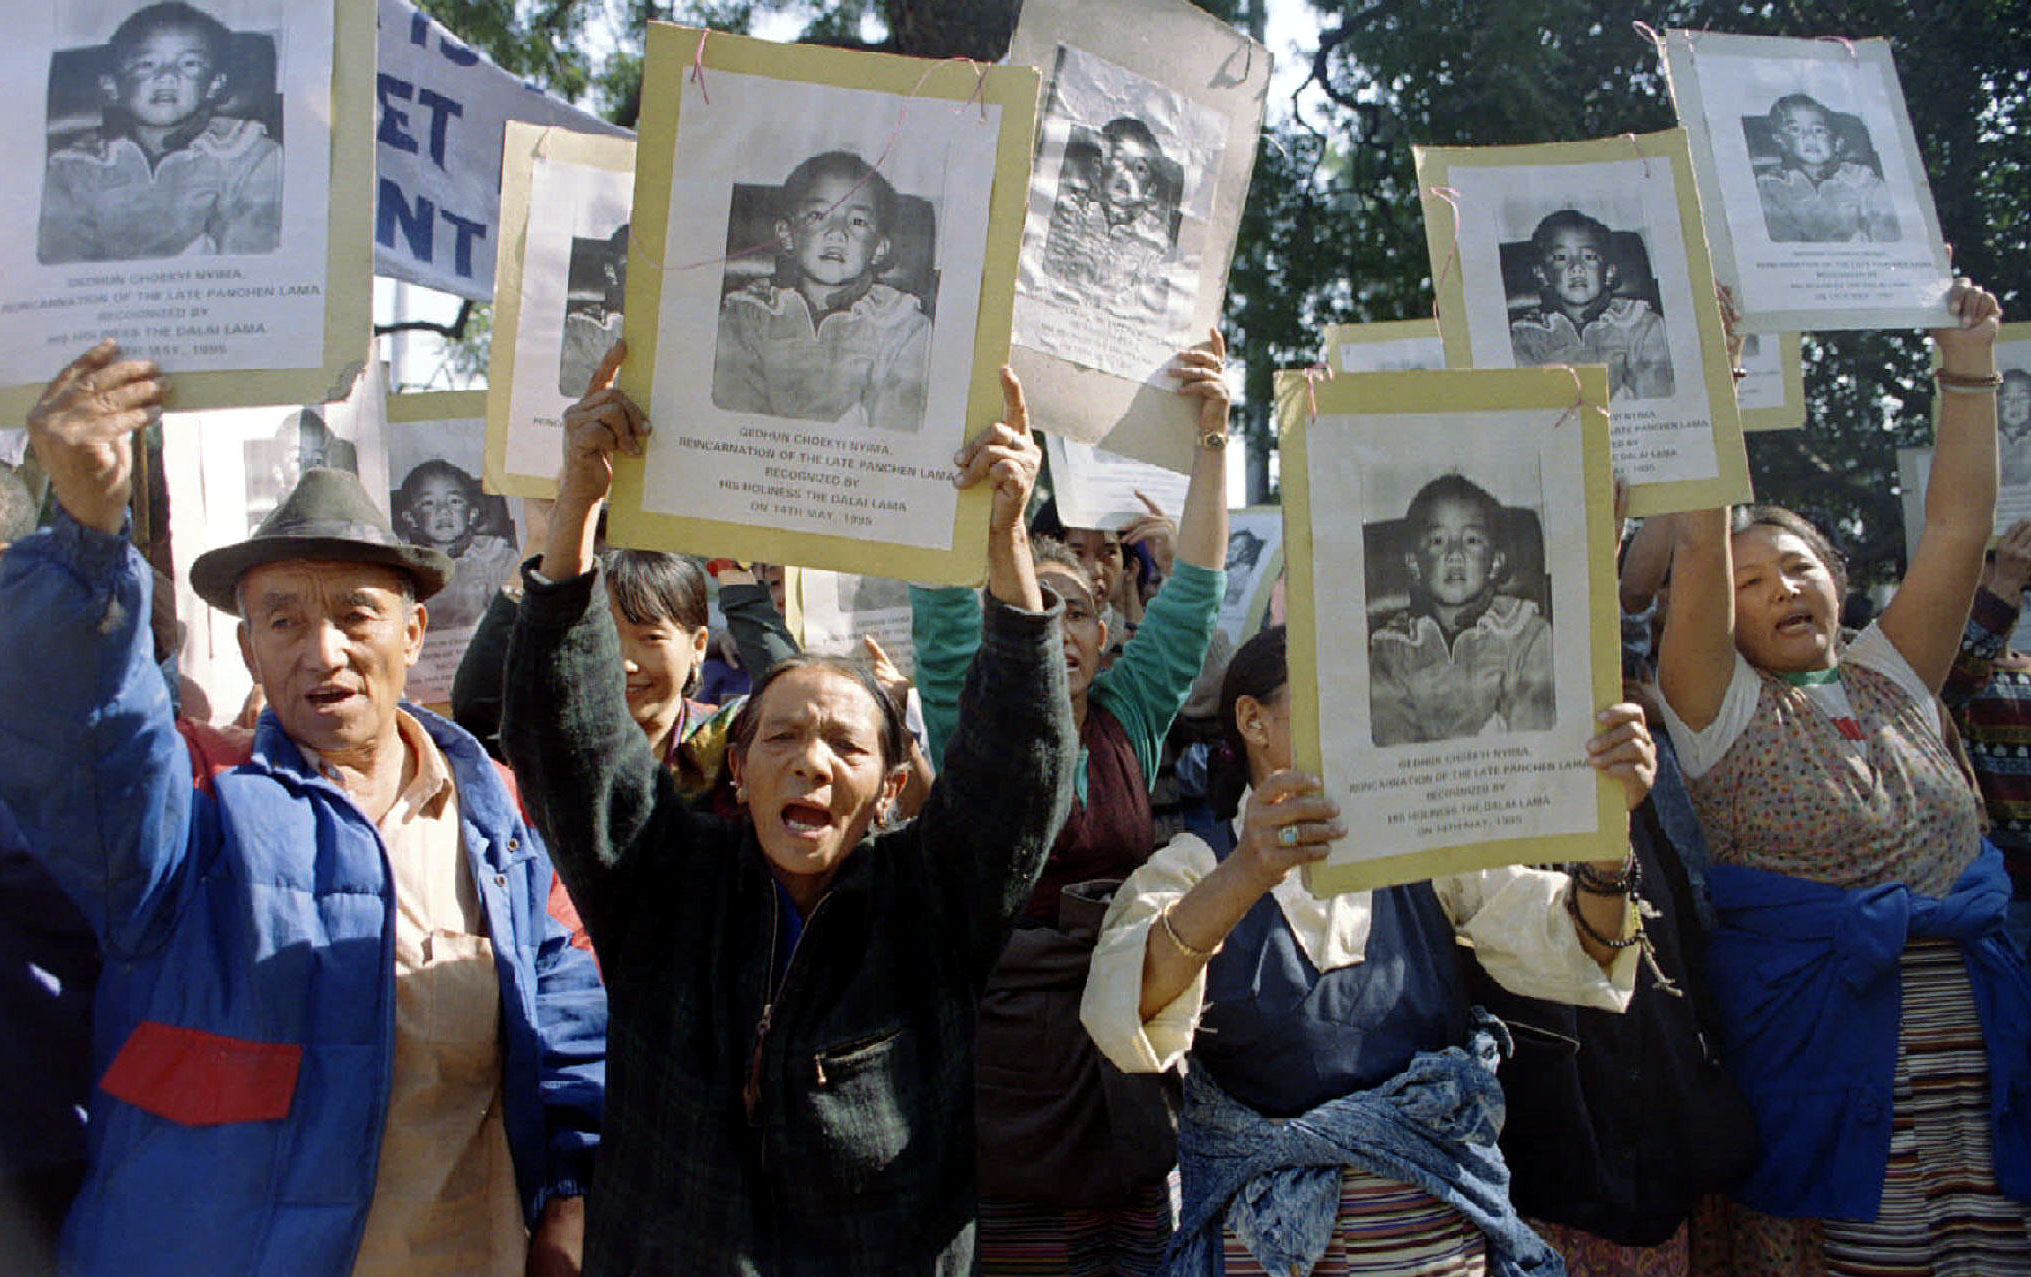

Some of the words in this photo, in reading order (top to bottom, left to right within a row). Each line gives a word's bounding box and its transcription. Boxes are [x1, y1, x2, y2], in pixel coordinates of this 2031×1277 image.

[207, 287, 275, 298] PANCHEN
[278, 284, 321, 296] LAMA
[225, 322, 267, 335] LAMA
[679, 436, 775, 459] REINCARNATION
[780, 450, 795, 461] OF
[800, 453, 822, 465] THE
[826, 456, 855, 469] LATE
[860, 461, 917, 477] PANCHEN
[765, 466, 841, 486] RECOGNIZED
[844, 475, 860, 488] BY
[743, 482, 802, 499] HOLINESS
[806, 490, 827, 502] THE
[832, 494, 868, 508] DALAI
[872, 498, 907, 512] LAMA
[1474, 765, 1499, 776] LATE
[1504, 762, 1555, 774] PANCHEN
[1493, 783, 1506, 794] BY
[1519, 796, 1551, 809] LAMA
